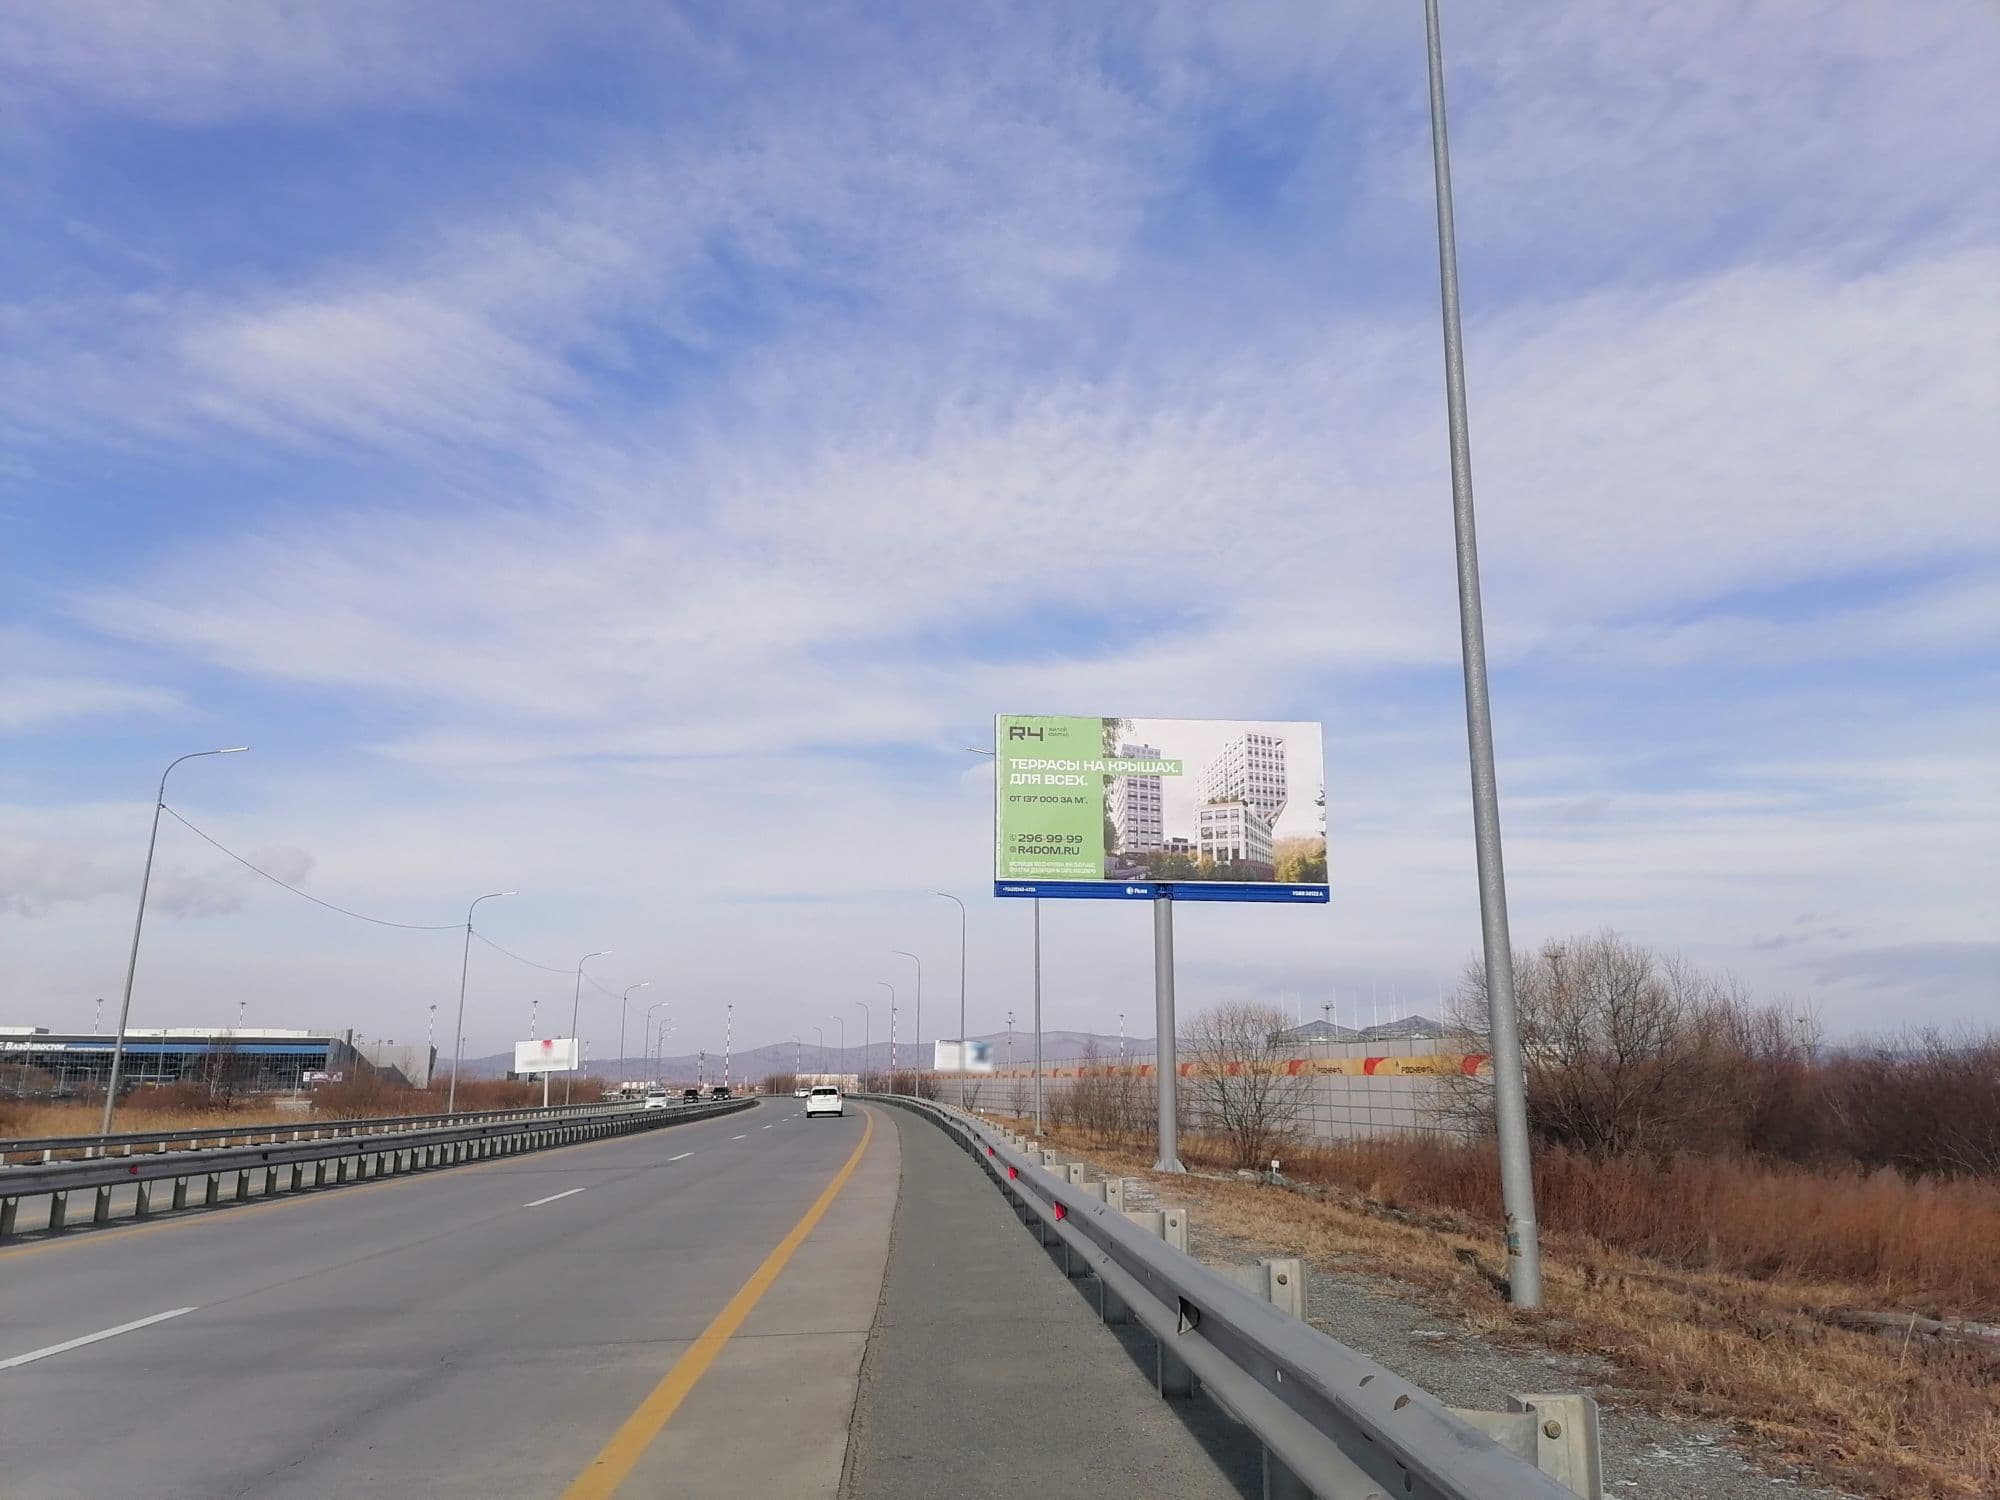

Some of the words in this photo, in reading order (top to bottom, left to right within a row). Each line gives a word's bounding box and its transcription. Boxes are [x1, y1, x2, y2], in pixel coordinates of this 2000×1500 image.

[1010, 726, 1044, 741] R4
[1009, 758, 1080, 771] ТЕРРАСЫ
[1084, 760, 1106, 772] НА
[1108, 761, 1179, 773] КРЫШАХ.
[1009, 773, 1041, 785] ДЛЯ
[1044, 774, 1088, 786] ВСЕХ.
[1009, 795, 1022, 803] ОТ
[1023, 795, 1038, 803] 137
[1061, 796, 1074, 804] ЗА
[1018, 846, 1080, 855] R4DOM.RU
